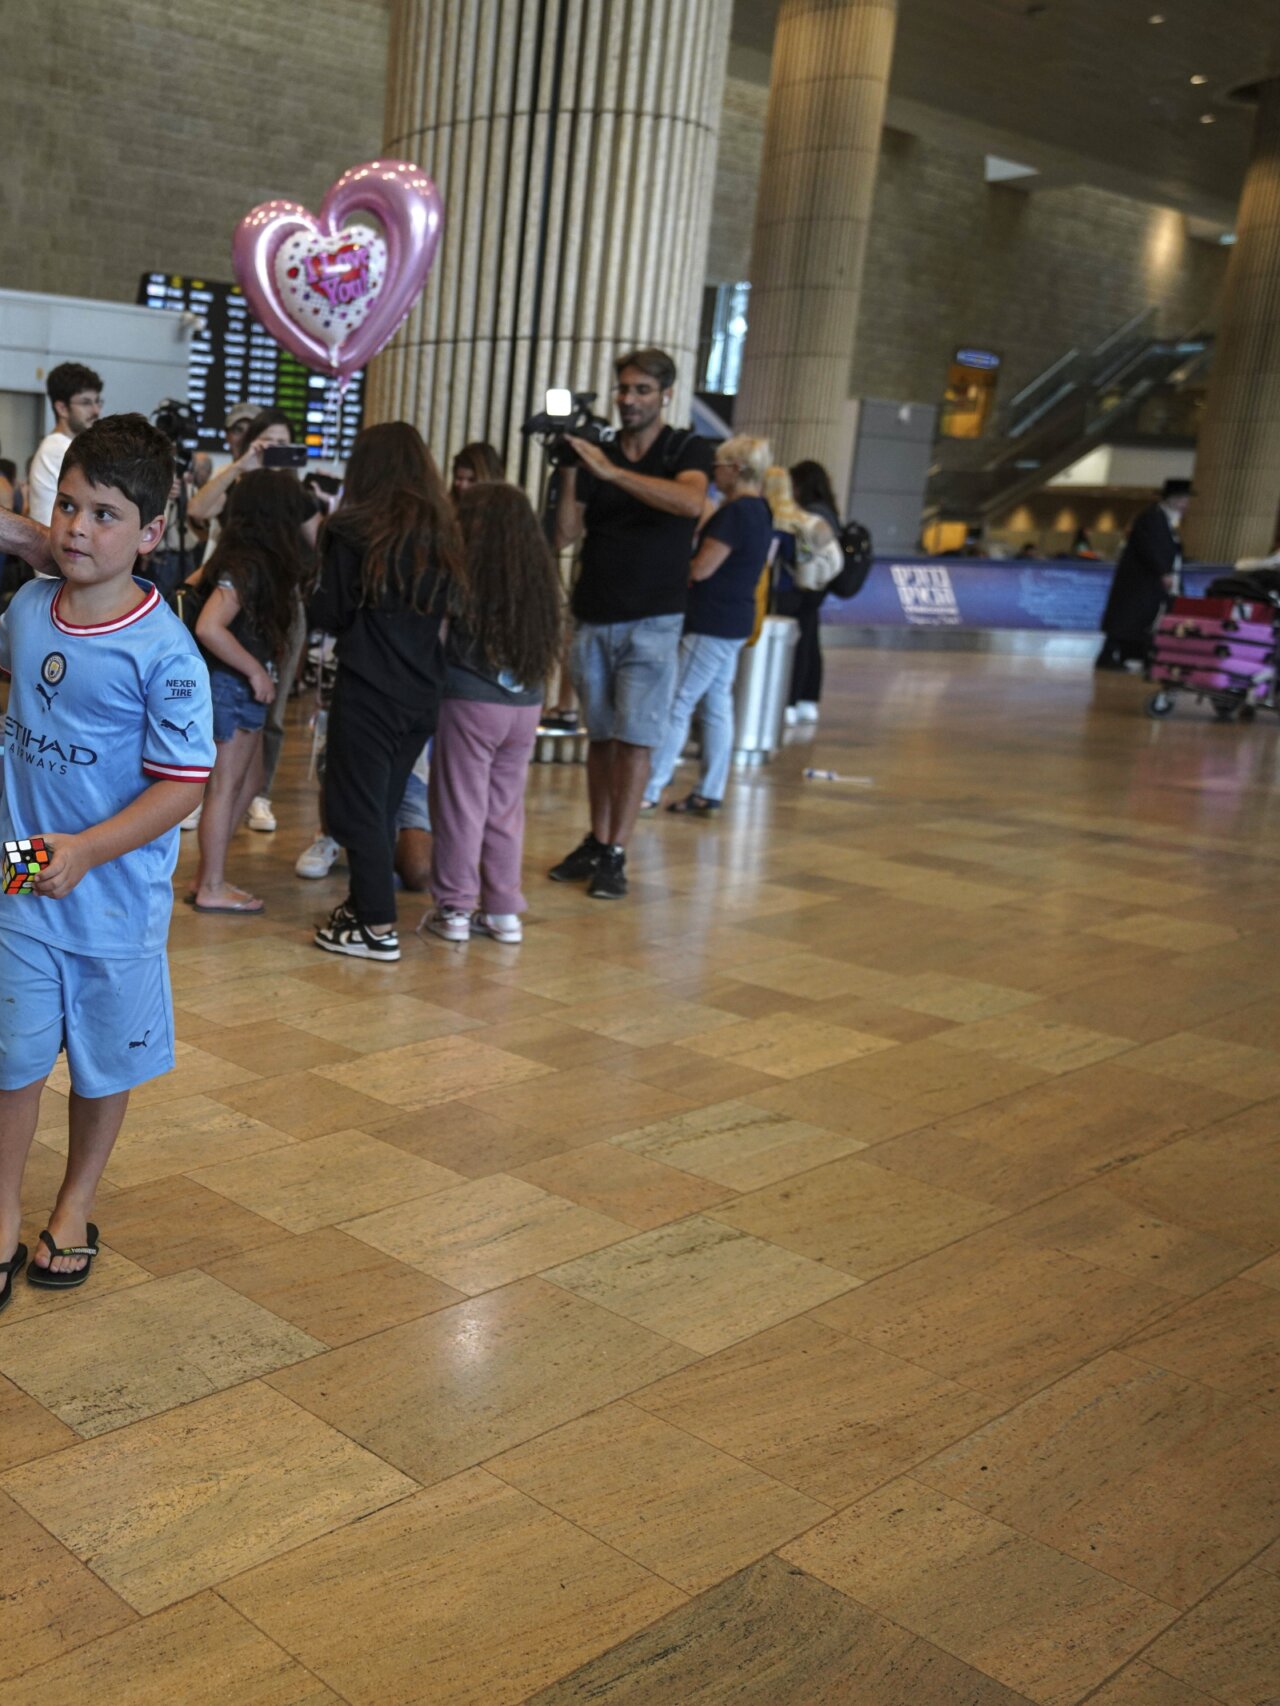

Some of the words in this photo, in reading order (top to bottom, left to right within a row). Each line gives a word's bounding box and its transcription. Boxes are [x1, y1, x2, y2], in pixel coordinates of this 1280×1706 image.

[165, 679, 196, 688] NEXEN
[171, 688, 193, 697] TIRE
[5, 716, 98, 766] ETIHAD
[9, 743, 68, 775] AIRWAYS
